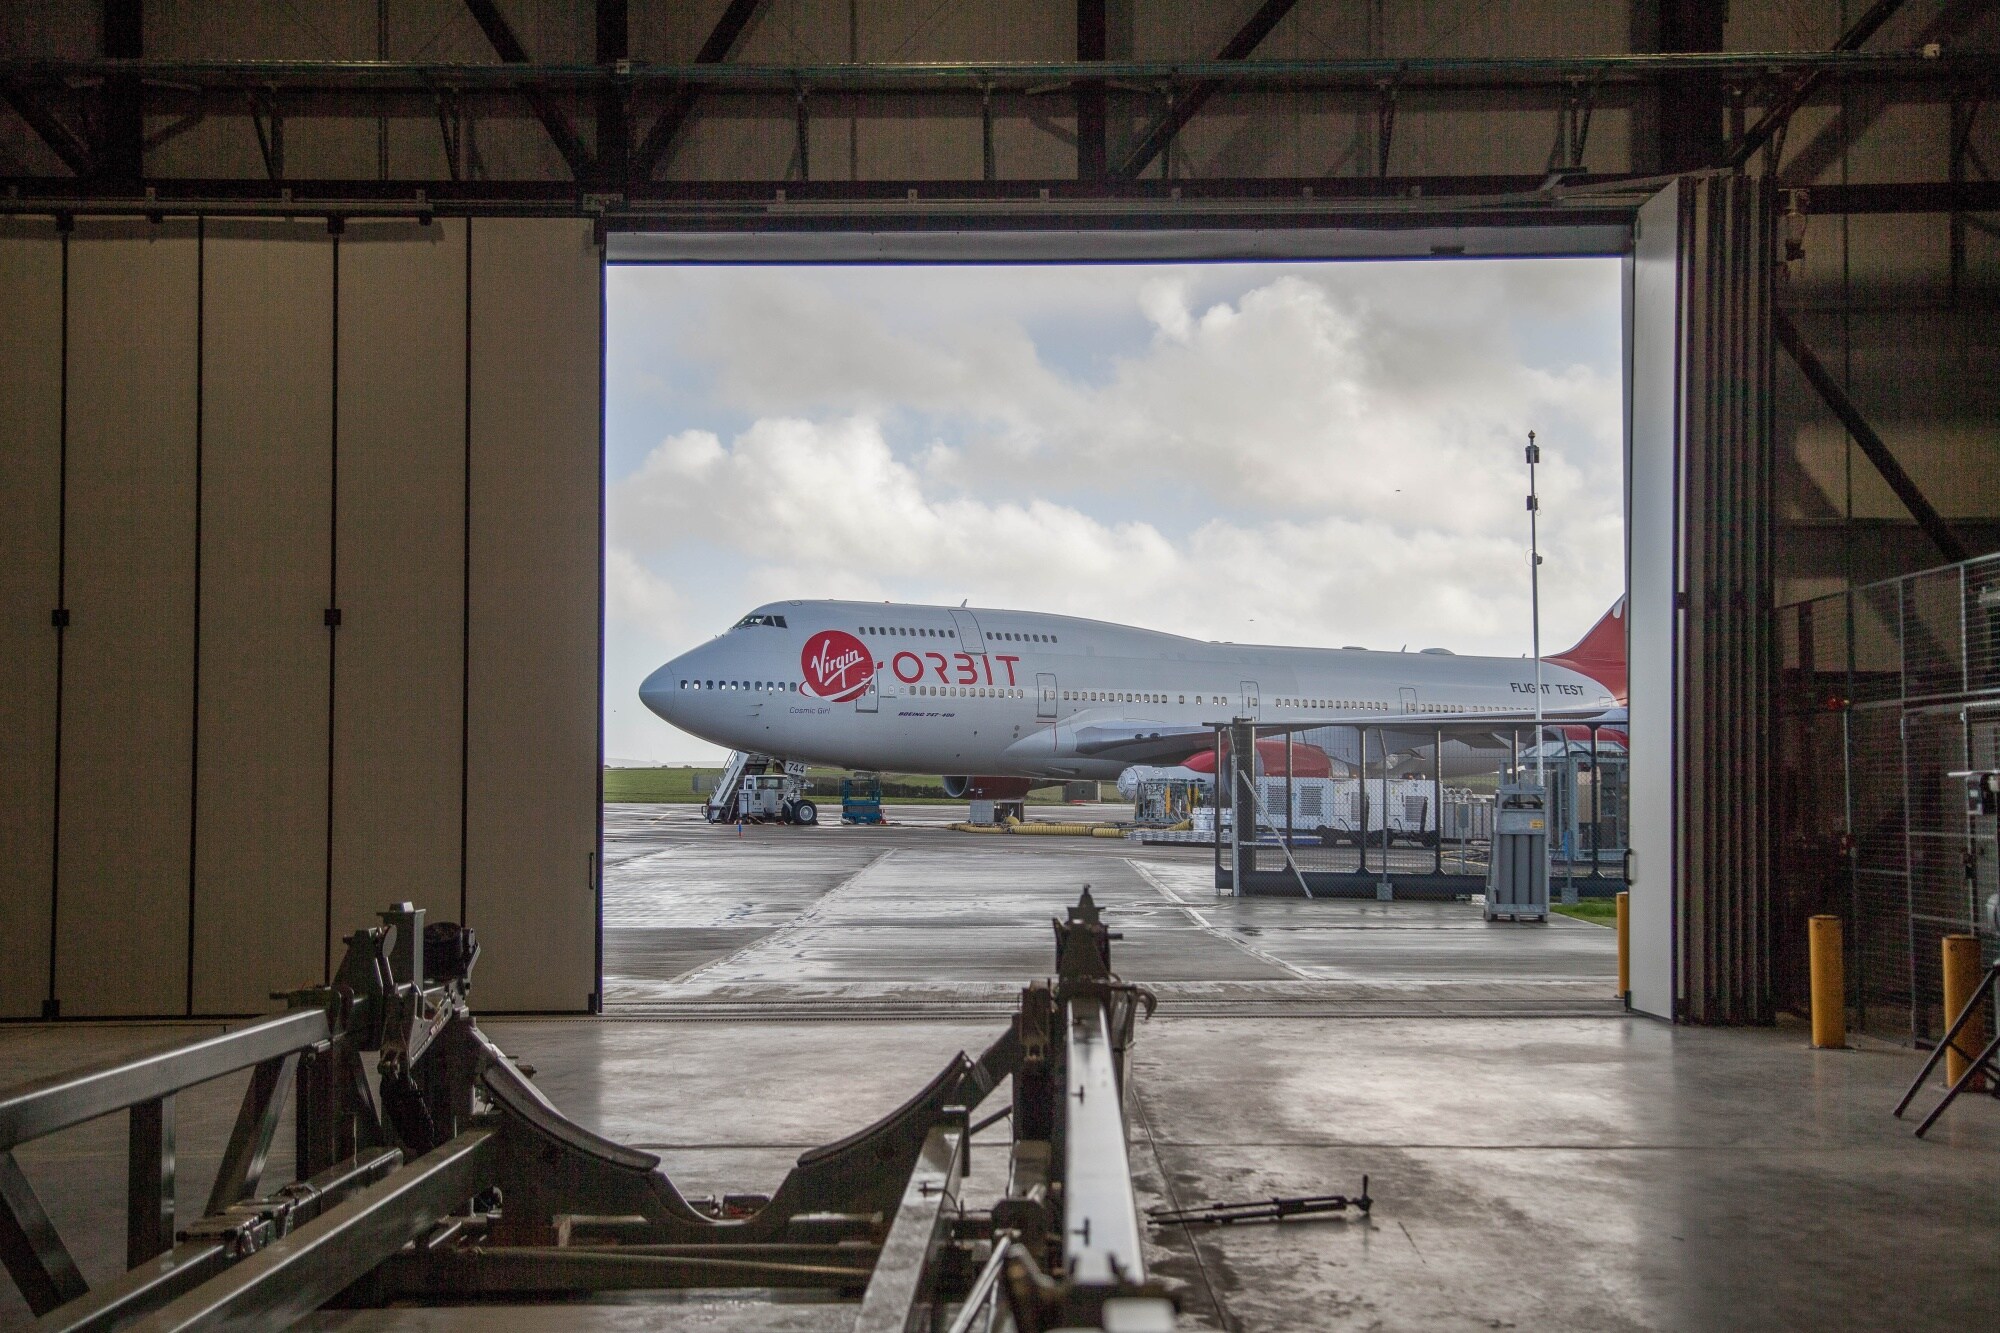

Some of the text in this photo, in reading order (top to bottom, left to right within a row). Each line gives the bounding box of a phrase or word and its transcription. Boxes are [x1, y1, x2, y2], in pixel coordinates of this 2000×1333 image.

[811, 639, 1020, 688] Virgin ORBIT
[1555, 684, 1584, 696] TEST
[789, 706, 816, 714] Cosmic
[788, 762, 805, 773] 744
